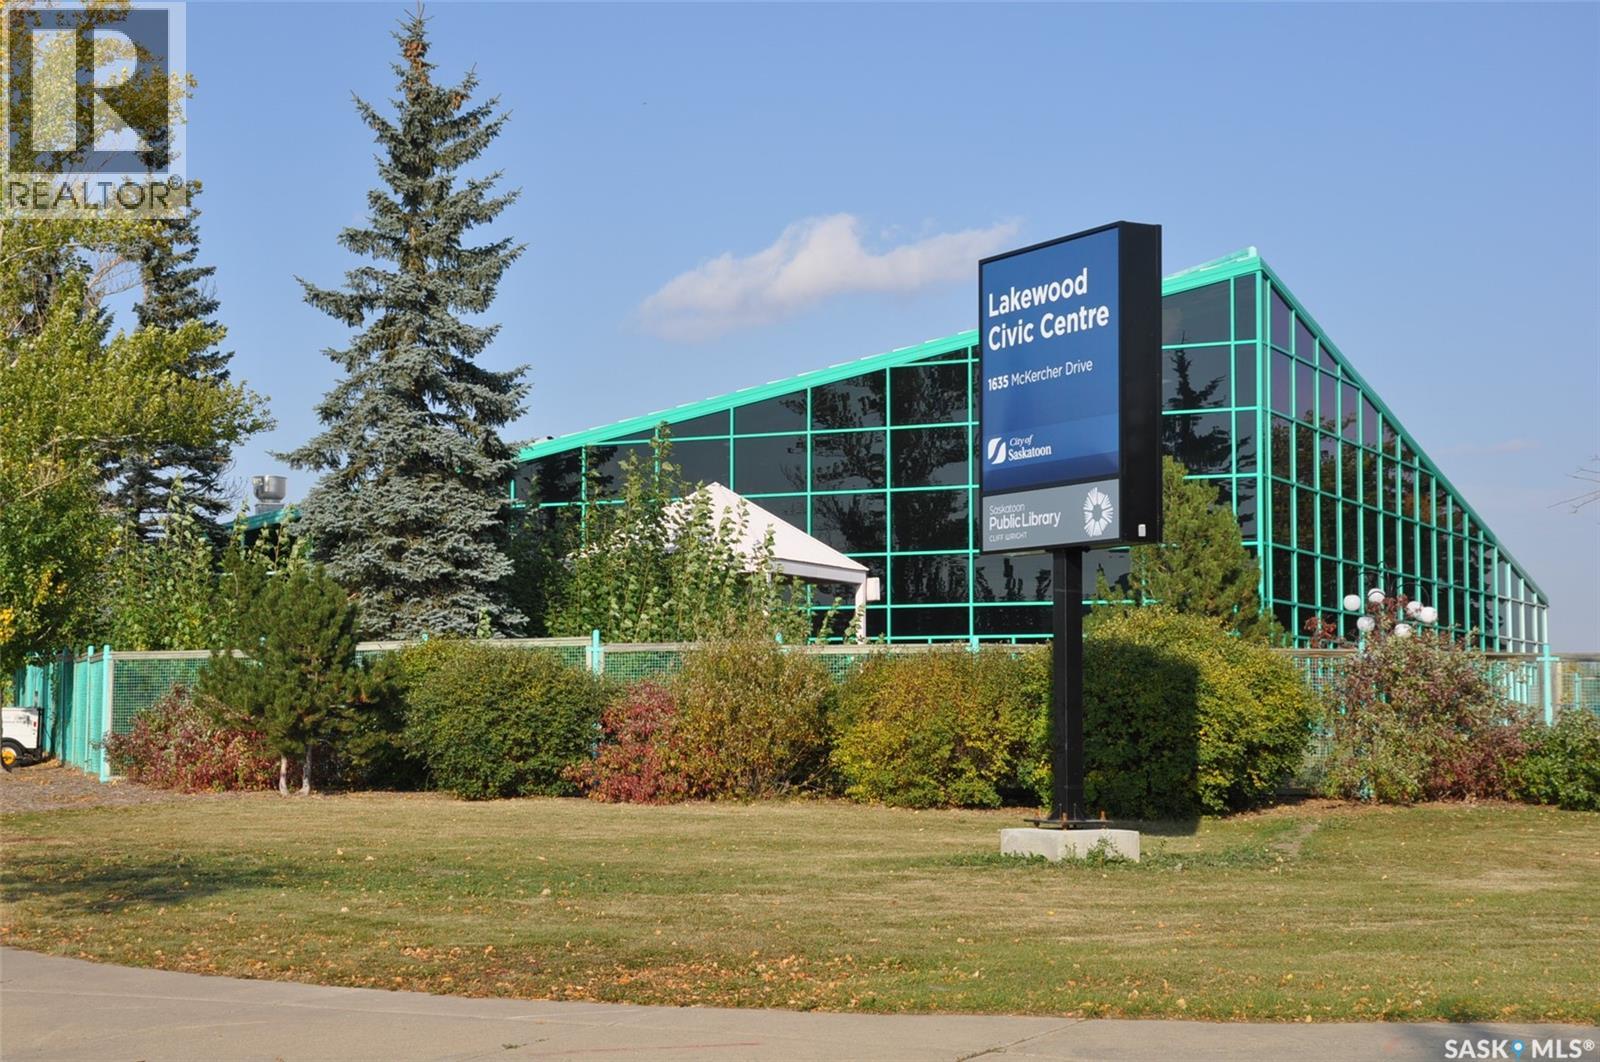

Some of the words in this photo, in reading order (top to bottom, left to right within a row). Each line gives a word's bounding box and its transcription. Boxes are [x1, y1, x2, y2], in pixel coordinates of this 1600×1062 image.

[988, 267, 1088, 318] Lakewood
[988, 319, 1034, 351] Civic
[1040, 304, 1110, 339] Centre
[988, 374, 1009, 392] 1635
[1011, 366, 1063, 386] McKercher
[1065, 359, 1093, 375] Drive
[1009, 437, 1024, 447] City
[1024, 434, 1034, 445] of
[1008, 445, 1052, 462] Saskatoon
[989, 504, 1025, 515] Saskatoon
